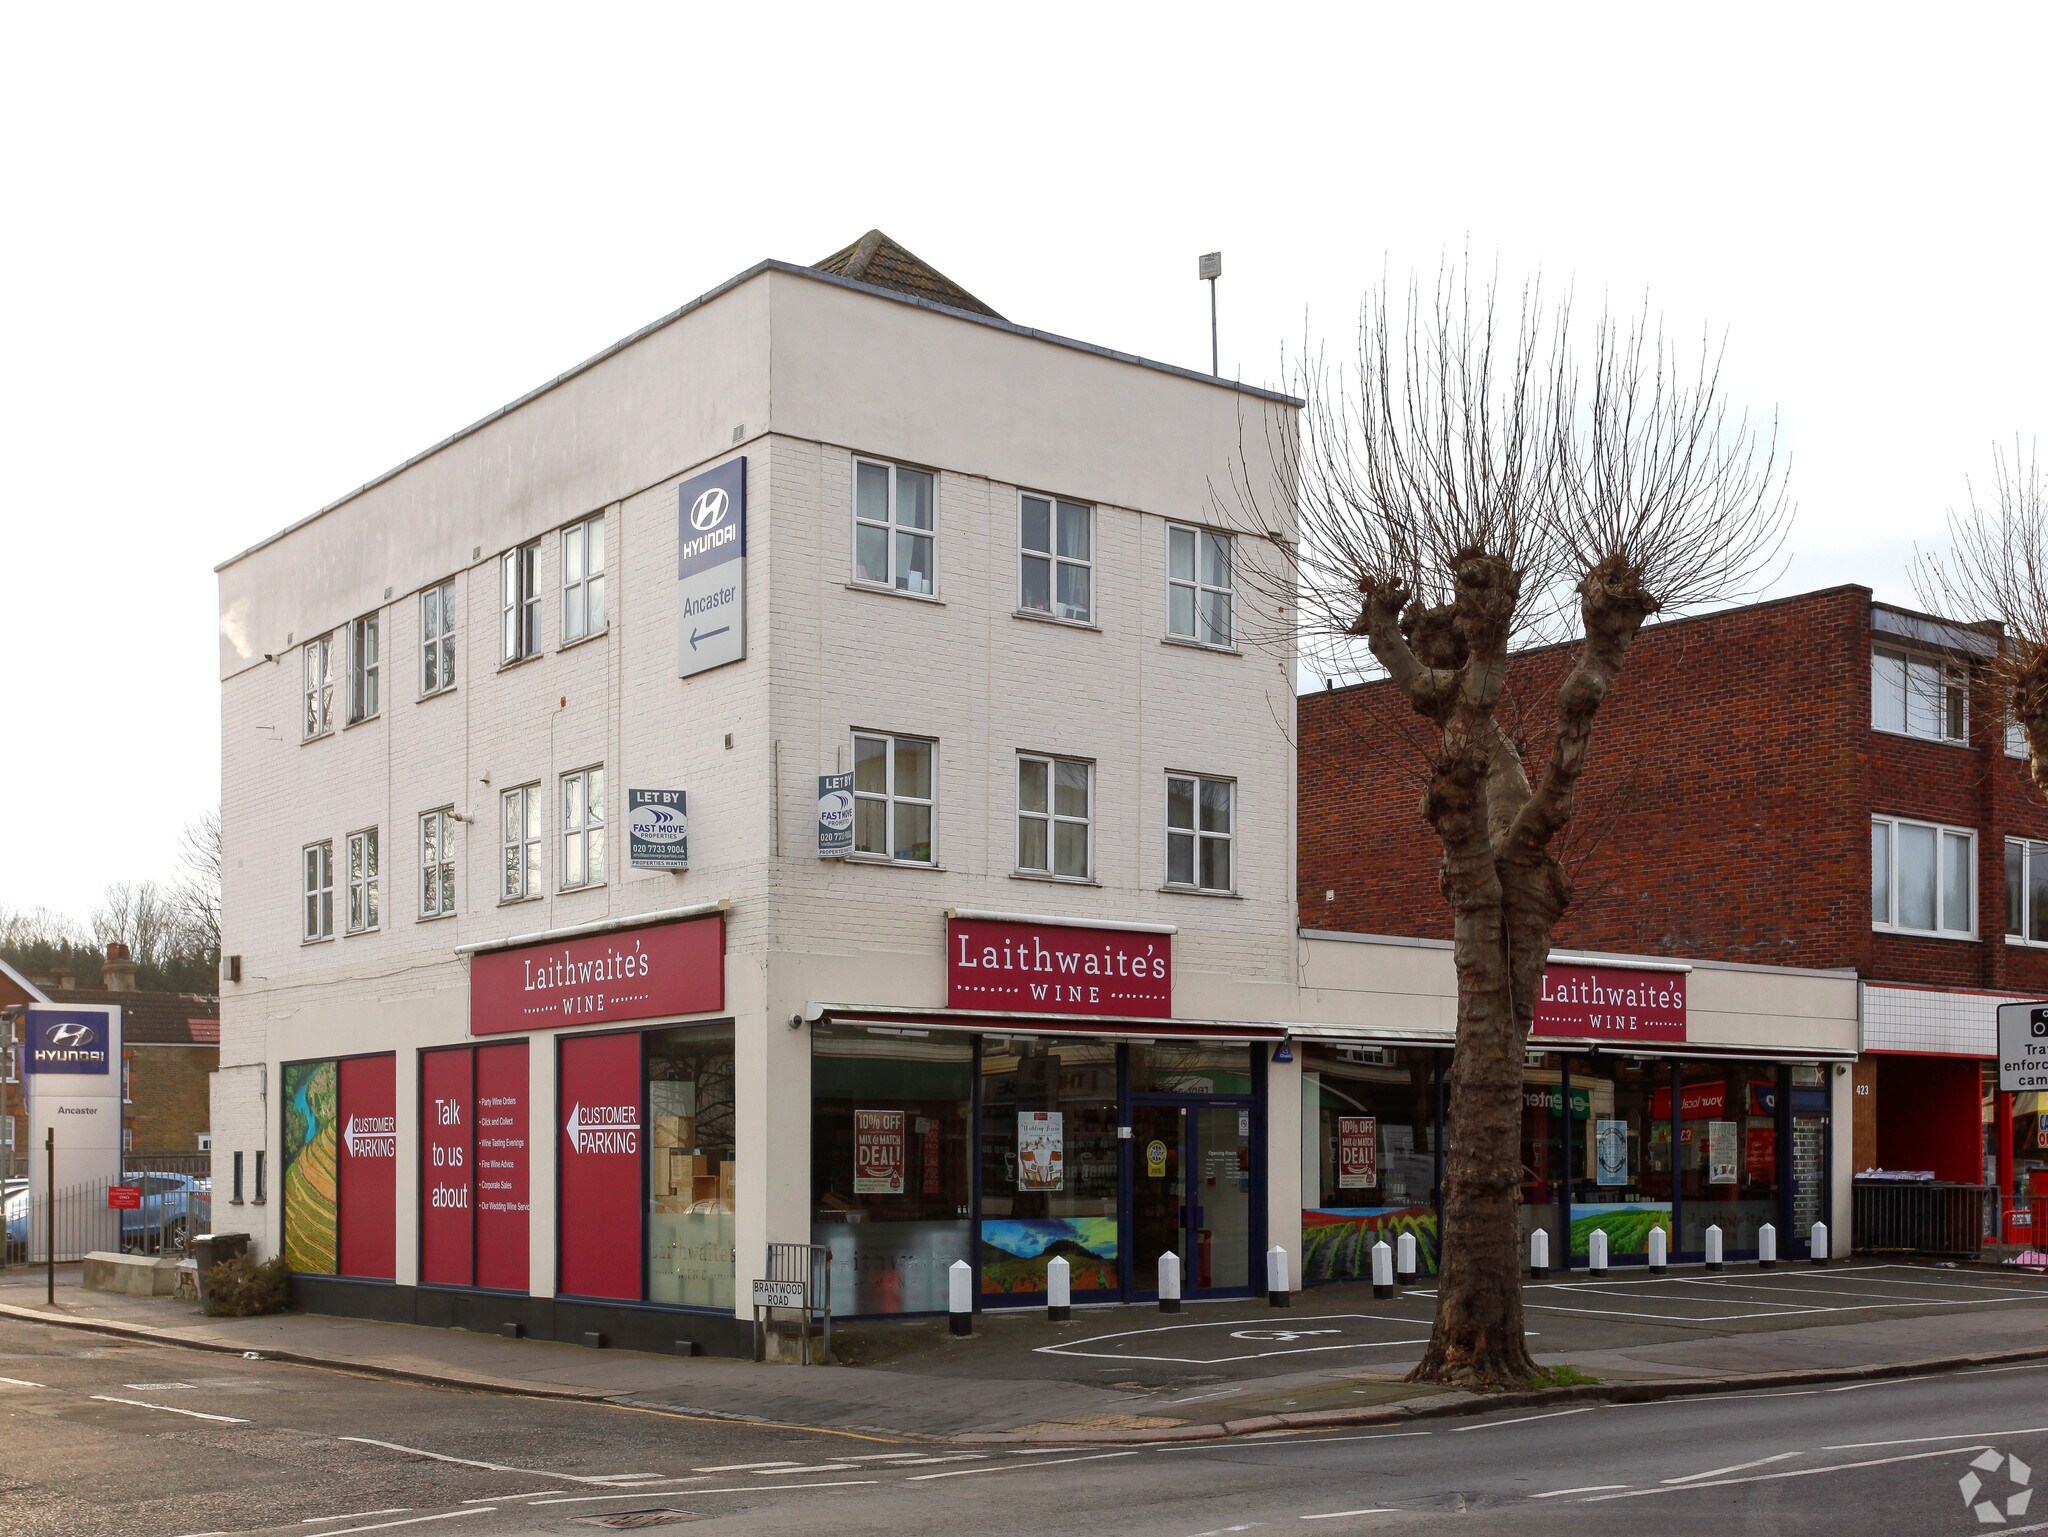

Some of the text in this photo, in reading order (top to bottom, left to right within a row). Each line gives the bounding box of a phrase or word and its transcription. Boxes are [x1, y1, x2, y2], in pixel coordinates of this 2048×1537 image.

[683, 523, 736, 560] HYUNDAI
[683, 586, 736, 618] Ancaster
[826, 775, 852, 789] LET BY
[637, 791, 680, 803] LET BY
[821, 808, 853, 820] FAST MOVE
[633, 824, 685, 834] FAST MOVE
[820, 833, 833, 841] 020
[632, 844, 685, 854] 020 7733 9004
[957, 934, 1166, 979] Laithwaite's
[524, 939, 649, 991] Laithwaite's
[1029, 983, 1100, 1003] WINE
[1540, 974, 1683, 1009] Laithwaite's
[562, 994, 604, 1015] WINE
[1589, 1014, 1638, 1030] WINE
[35, 1050, 104, 1062] HYUNDAI
[2025, 1043, 2048, 1055] Tra
[2019, 1076, 2048, 1086] cam
[1856, 1085, 1869, 1095] 423
[492, 1097, 502, 1105] Wine
[502, 1097, 517, 1105] Orders
[57, 1106, 98, 1115] Ancaster
[435, 1098, 461, 1125] Talk
[580, 1106, 637, 1124] CUSTOMER
[353, 1116, 395, 1132] CUSTOMER
[491, 1118, 500, 1126] and
[859, 1114, 901, 1130] 10% OFF
[1342, 1120, 1374, 1134] 10% OFF
[481, 1139, 491, 1147] Wine
[580, 1131, 637, 1154] PARKING
[859, 1134, 871, 1145] MIX
[880, 1134, 901, 1145] MATCH
[1342, 1137, 1352, 1146] MIX
[1357, 1137, 1374, 1146] MATCH
[353, 1138, 395, 1157] PARKING
[432, 1141, 463, 1167] to us
[859, 1145, 901, 1166] DEAL!
[1343, 1147, 1374, 1165] DEAL!
[491, 1160, 501, 1168] Wine
[432, 1182, 468, 1208] about
[754, 1282, 803, 1295] BRANTWOOD
[767, 1295, 789, 1306] ROAD
